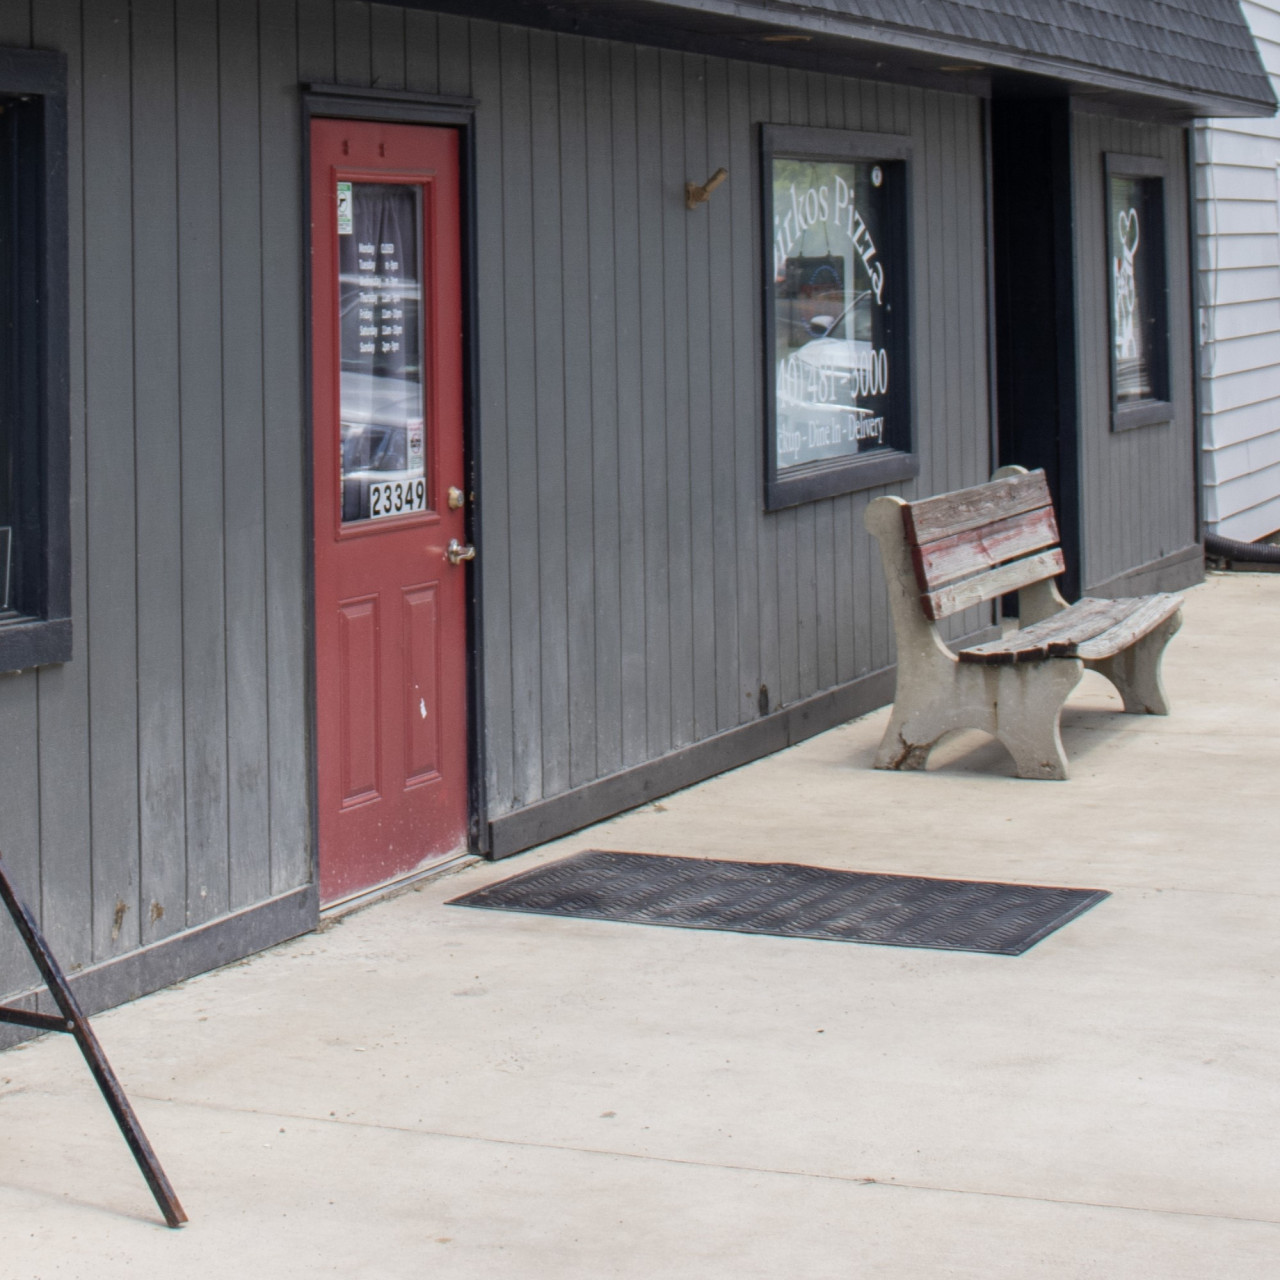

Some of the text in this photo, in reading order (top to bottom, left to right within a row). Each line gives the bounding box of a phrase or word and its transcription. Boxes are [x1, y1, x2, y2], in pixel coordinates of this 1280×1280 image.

[773, 174, 884, 305] irkos Pizza
[808, 421, 830, 448] Dine
[848, 411, 884, 444] Delivery
[372, 480, 424, 516] 23349
